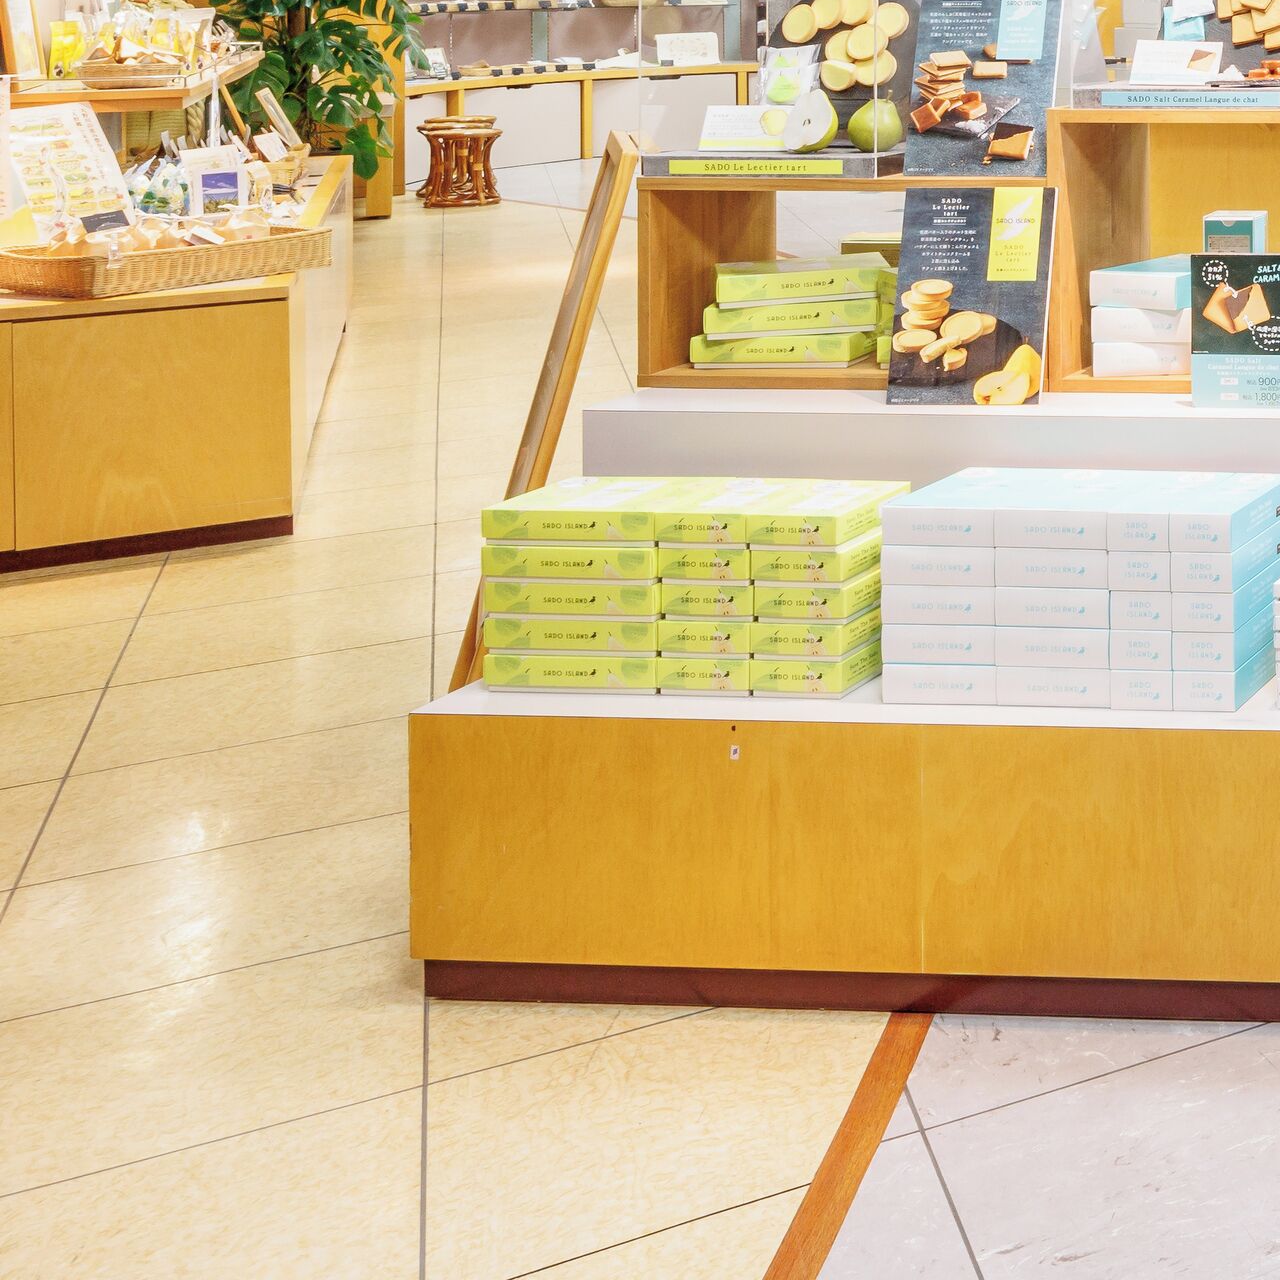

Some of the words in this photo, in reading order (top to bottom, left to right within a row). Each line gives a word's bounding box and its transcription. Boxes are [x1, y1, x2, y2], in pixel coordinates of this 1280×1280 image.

[1128, 95, 1150, 103] SADO
[1154, 95, 1170, 103] Salt
[1172, 95, 1202, 103] Caramel
[1204, 95, 1229, 104] Langue
[705, 163, 730, 171] SADO
[733, 163, 744, 171] Le
[747, 163, 782, 171] Lectier
[786, 163, 806, 171] tart
